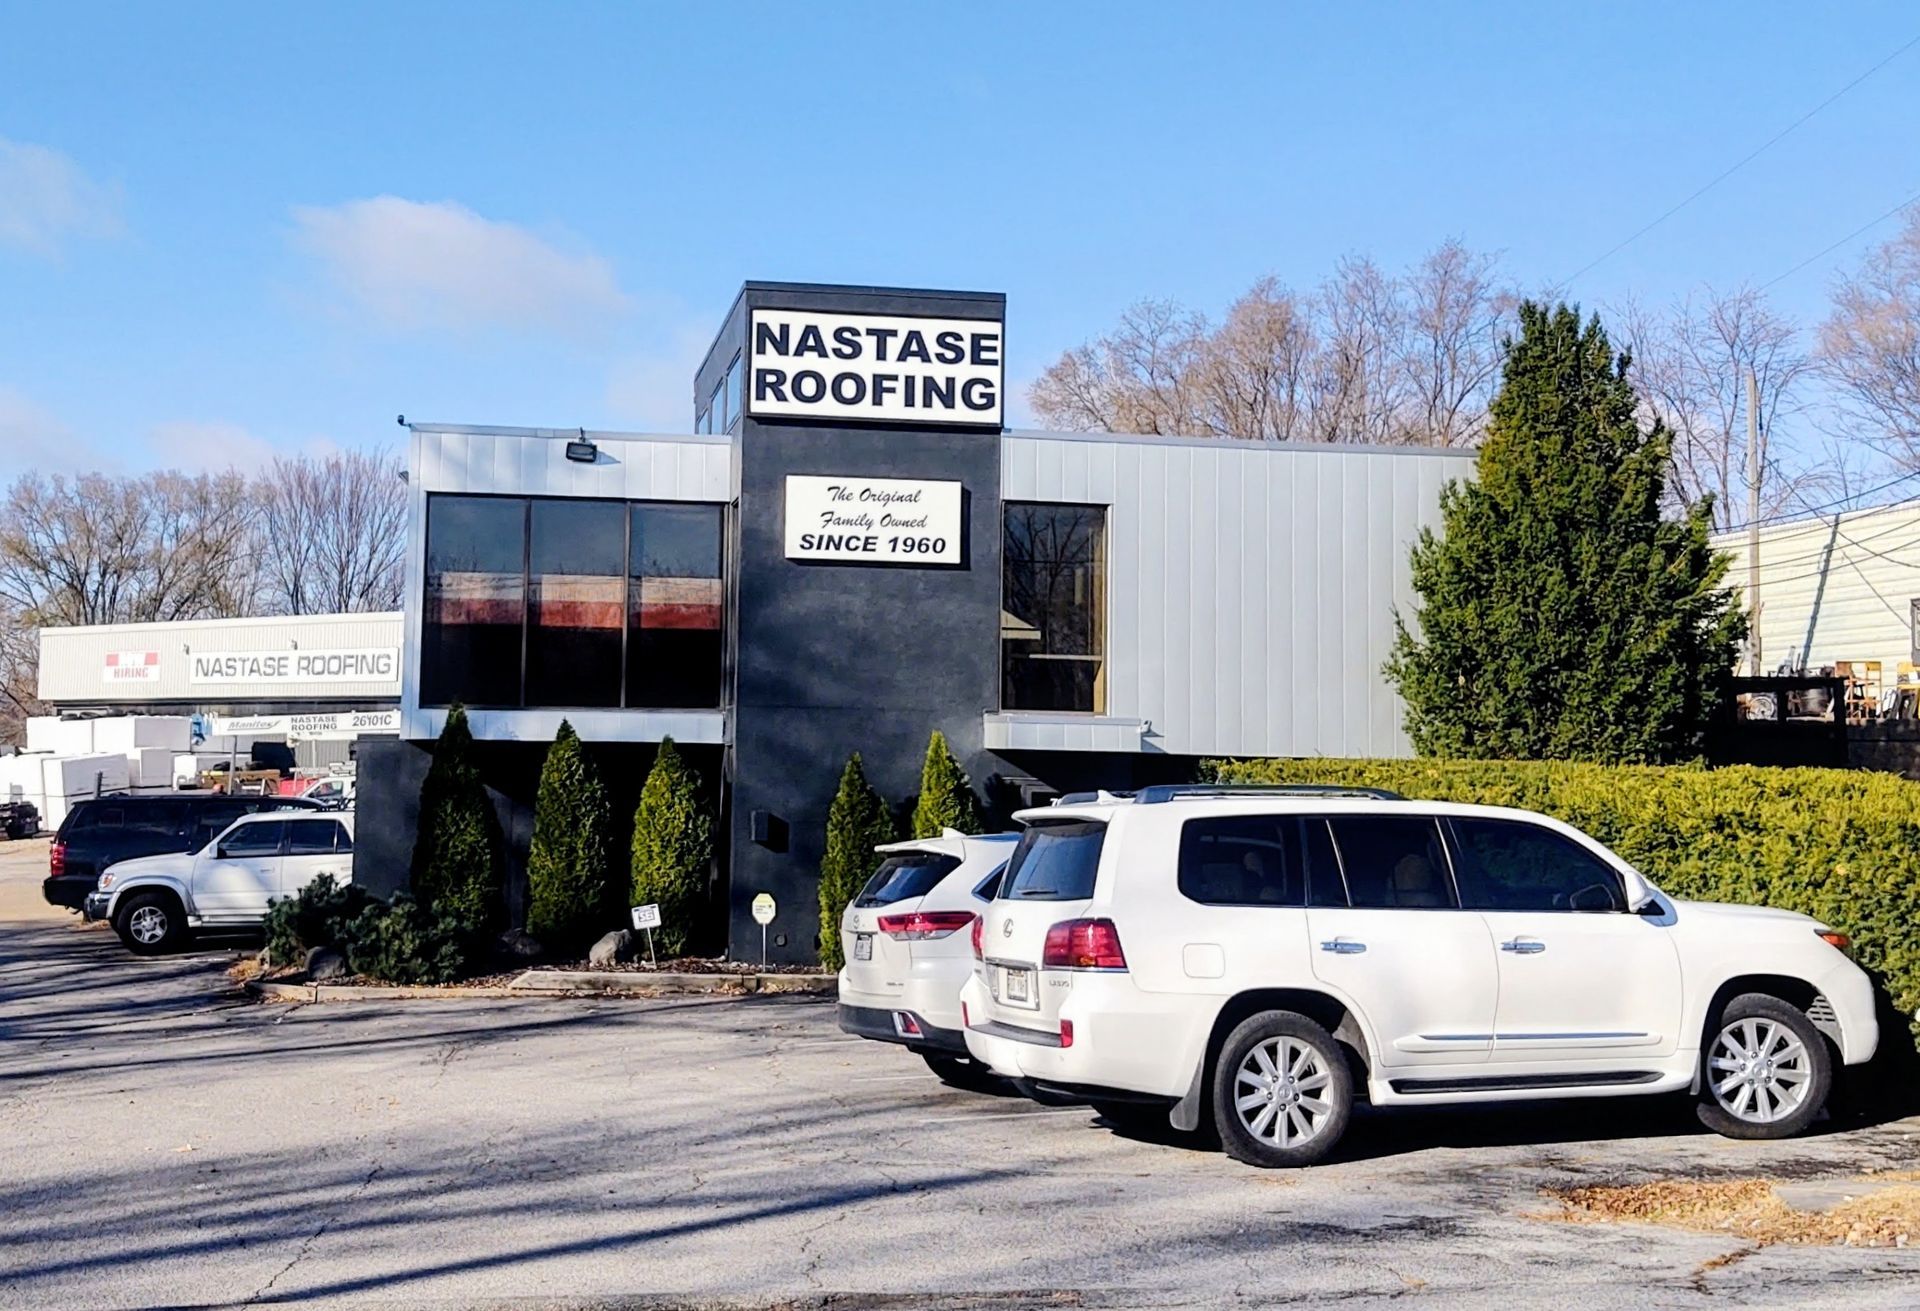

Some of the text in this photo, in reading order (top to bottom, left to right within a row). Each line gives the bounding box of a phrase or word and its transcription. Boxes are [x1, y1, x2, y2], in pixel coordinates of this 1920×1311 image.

[756, 322, 999, 366] NASTASE
[755, 368, 996, 411] ROOFING
[827, 486, 922, 508] The Original
[820, 511, 928, 530] Family Owned
[799, 533, 946, 554] SINCE 1960
[113, 667, 149, 679] HIRING
[195, 653, 392, 678] NASTASE ROOFING
[291, 715, 337, 723] NASTASE
[291, 723, 337, 731] ROOFING
